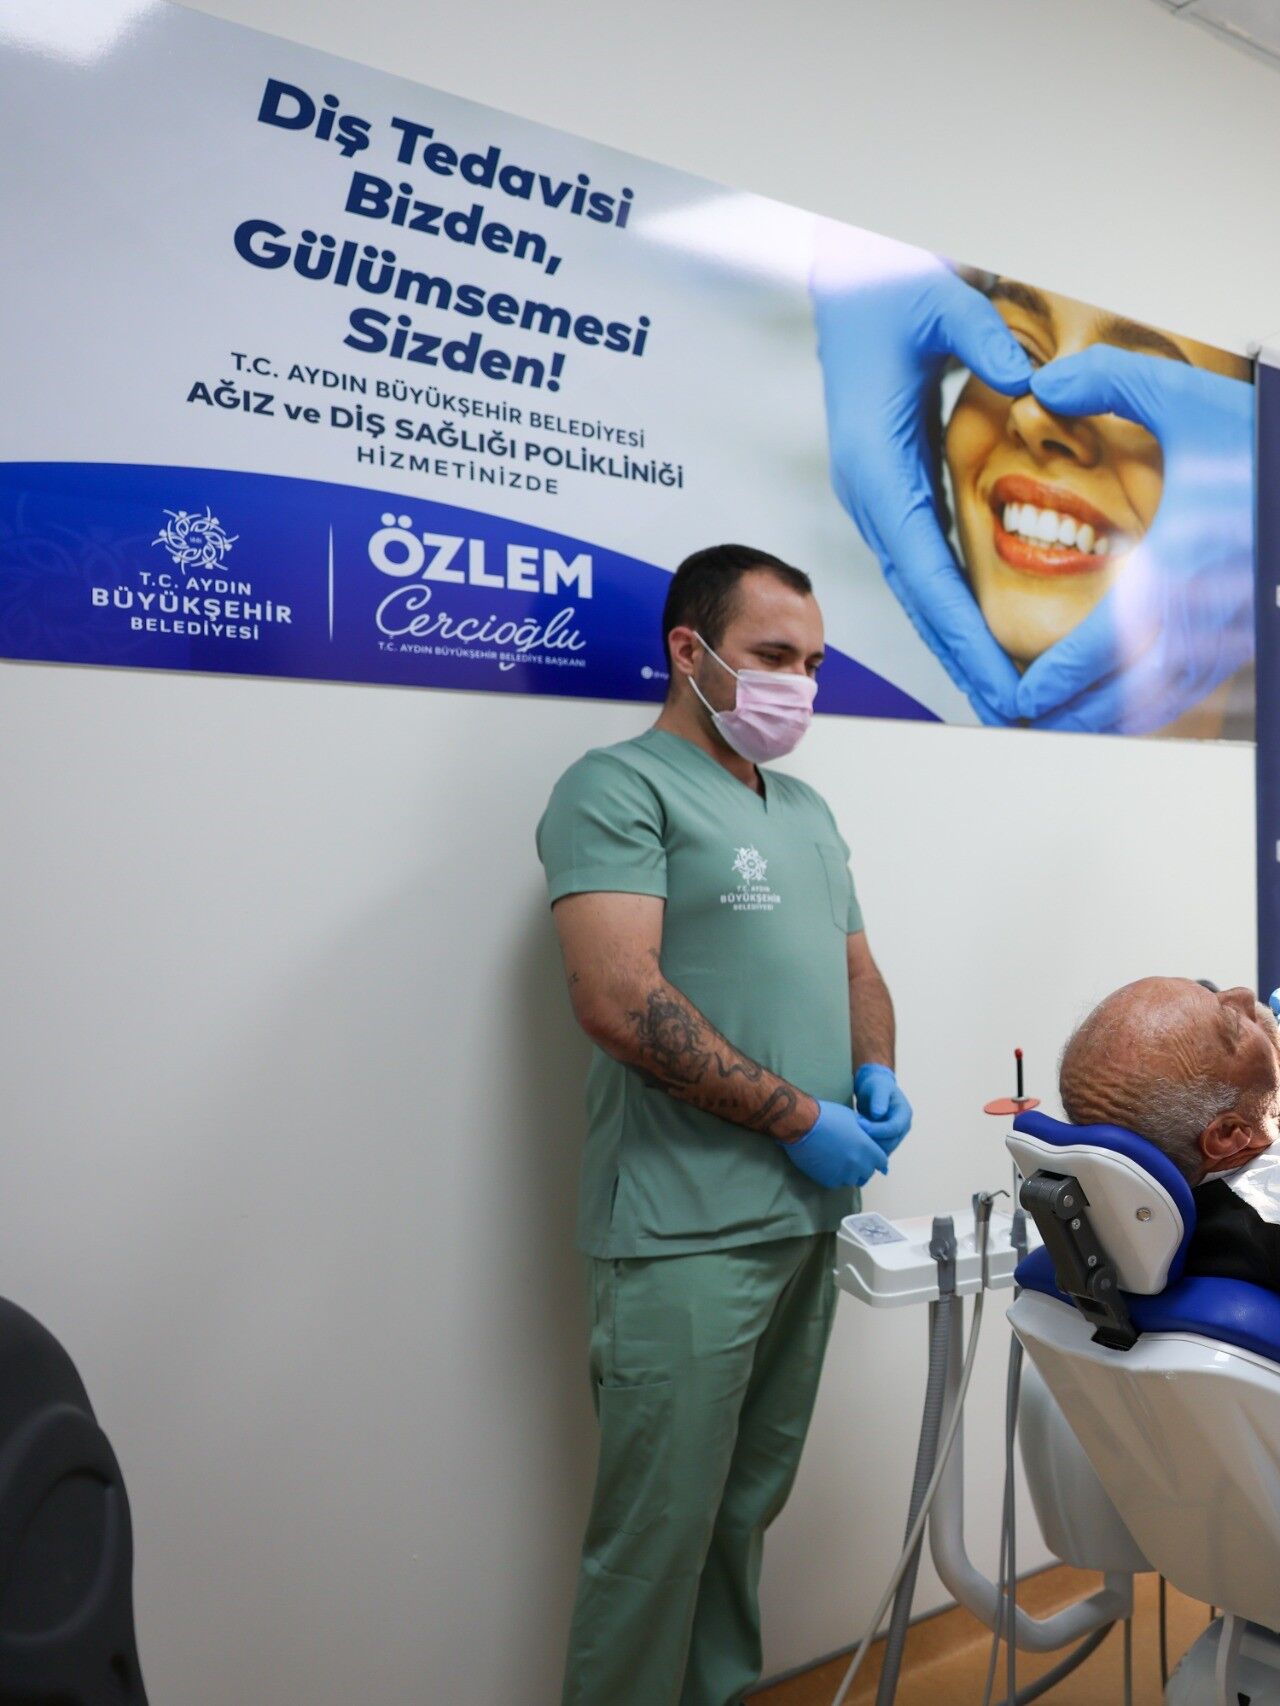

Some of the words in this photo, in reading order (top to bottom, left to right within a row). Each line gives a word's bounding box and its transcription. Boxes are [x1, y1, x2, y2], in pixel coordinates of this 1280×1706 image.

[257, 77, 372, 158] Diş
[391, 116, 634, 229] Tedavisi
[344, 170, 562, 276] Bizden,
[233, 219, 651, 357] Gülümsemesi
[343, 307, 566, 393] Sizden!
[186, 379, 275, 417] AĞIZ
[284, 403, 321, 425] ve
[330, 404, 386, 439] DİŞ
[395, 418, 516, 459] SAĞLIĞI
[525, 442, 683, 489] POLİKLİNİĞİ
[231, 352, 279, 378] T.C.
[287, 364, 367, 395] AYDIN
[376, 379, 522, 425] BÜYÜKŞEHİR
[530, 411, 645, 449] BELEDİYESİ
[357, 445, 559, 495] HİZMETİNİZDE
[139, 571, 179, 589] T.C.
[186, 577, 252, 596] AYDIN
[368, 512, 593, 600] ÖZLEM
[91, 585, 293, 624] BÜYÜKŞEHİR
[130, 616, 259, 641] BELEDİYESİ
[400, 644, 433, 655] AYDIN
[434, 646, 497, 661] BÜYÜKŞEHİR
[500, 651, 544, 664] BELEDİYE
[545, 655, 586, 668] BAŞKANI
